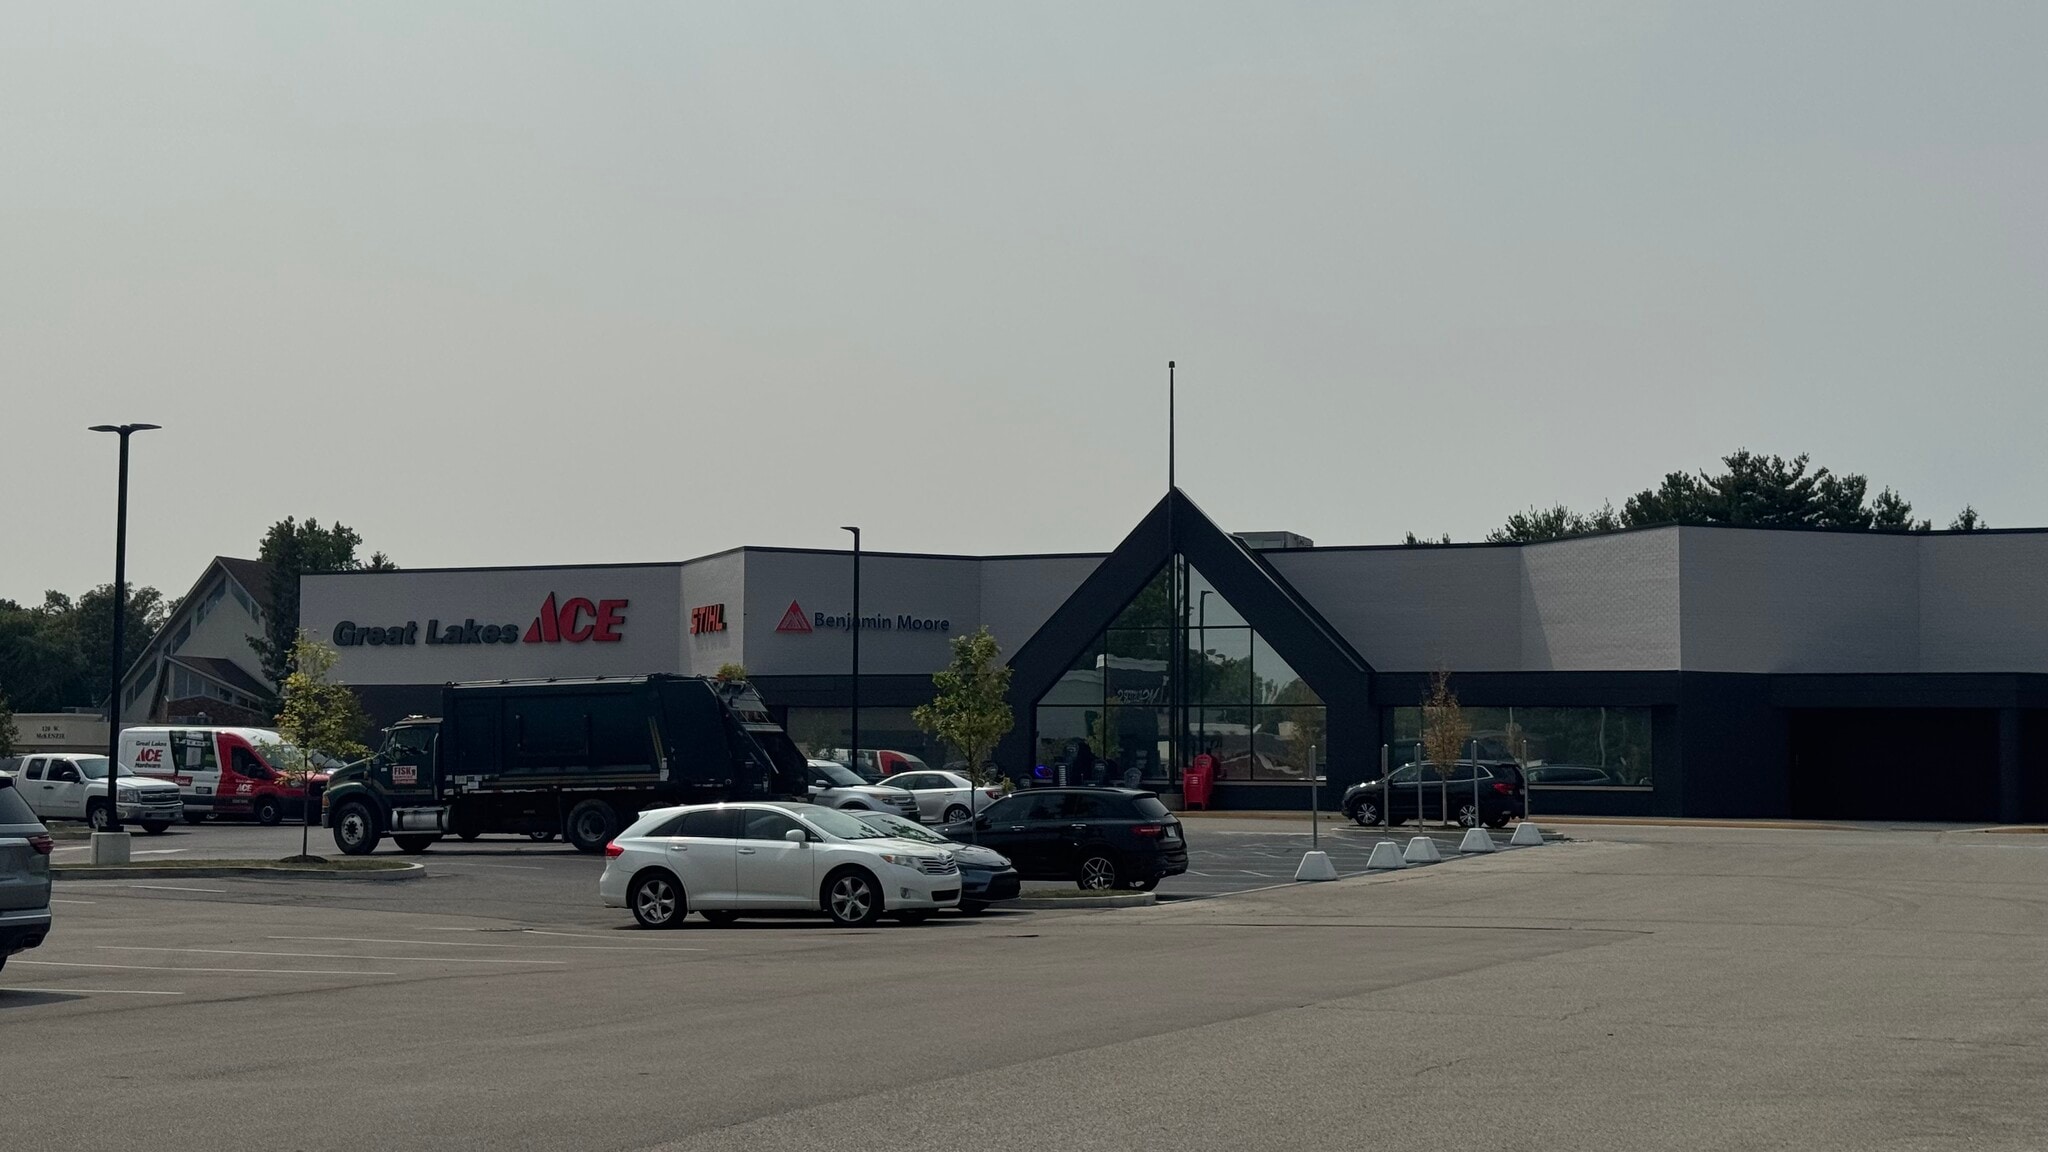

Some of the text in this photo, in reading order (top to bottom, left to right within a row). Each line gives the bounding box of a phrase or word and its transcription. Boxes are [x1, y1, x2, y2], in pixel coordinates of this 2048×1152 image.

[333, 591, 629, 646] Great Lakes ACE
[690, 604, 727, 635] STIHL
[897, 614, 950, 630] Moore
[136, 747, 163, 762] ACE
[394, 767, 411, 775] FISK
[236, 784, 253, 792] ACE
